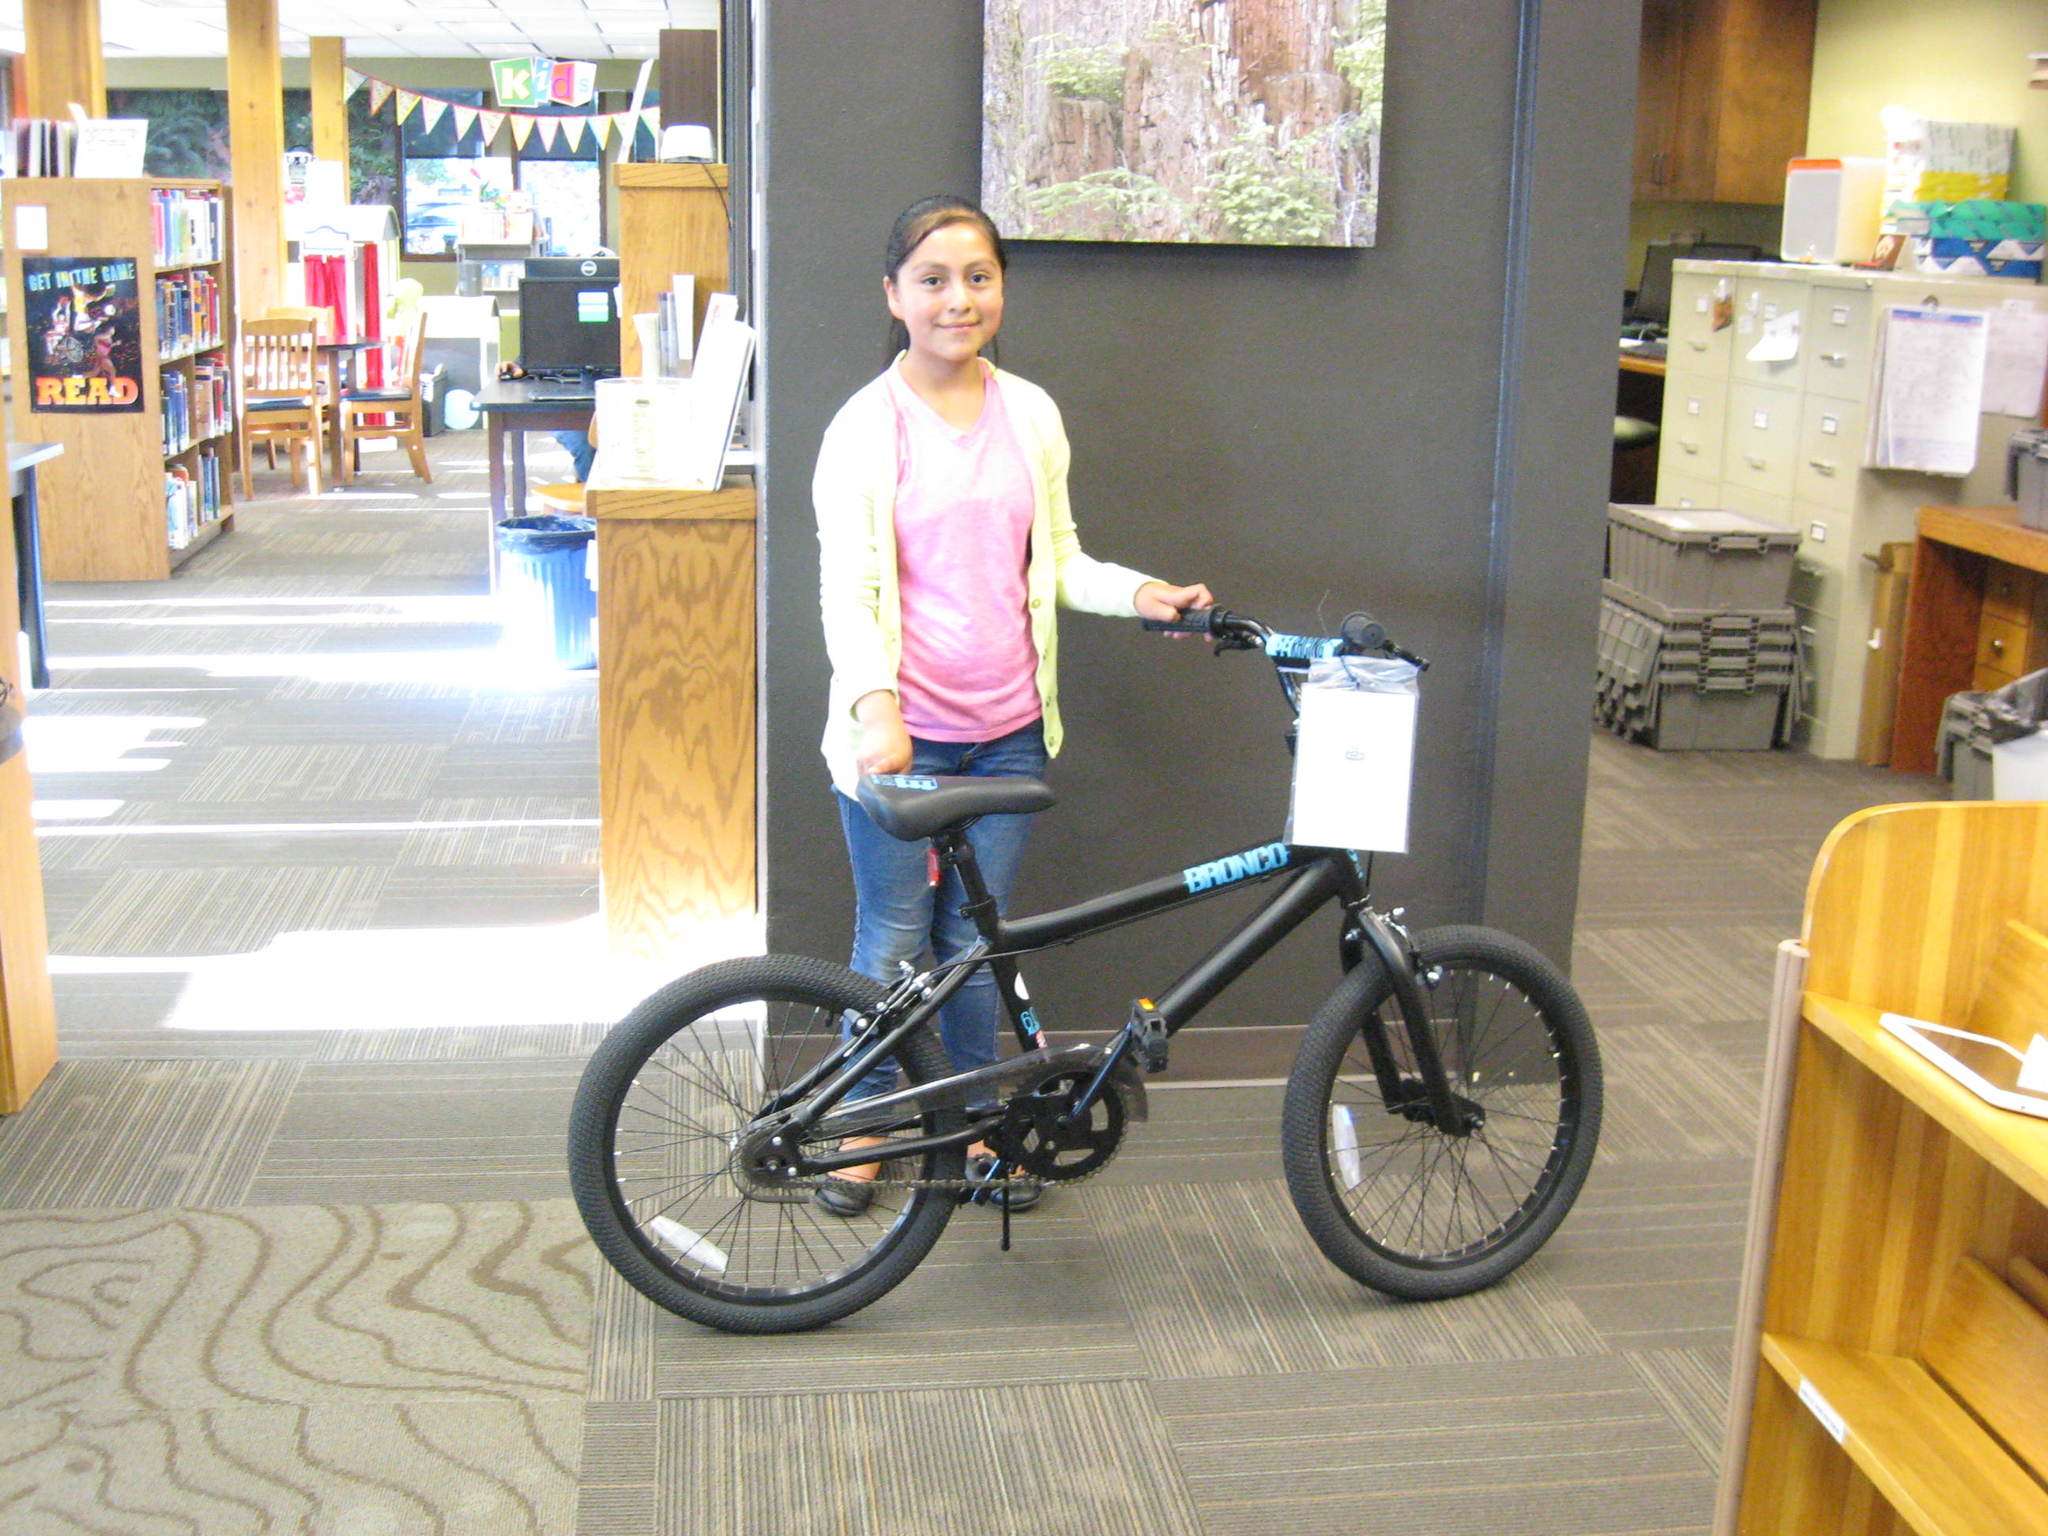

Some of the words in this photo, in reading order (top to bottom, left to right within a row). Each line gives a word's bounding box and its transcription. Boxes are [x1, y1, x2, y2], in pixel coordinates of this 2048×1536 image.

[28, 273, 52, 291] GET
[55, 271, 71, 288] IN
[71, 267, 98, 284] THE
[101, 263, 135, 282] GAME
[35, 376, 138, 405] READ
[1183, 842, 1289, 893] BRONCO
